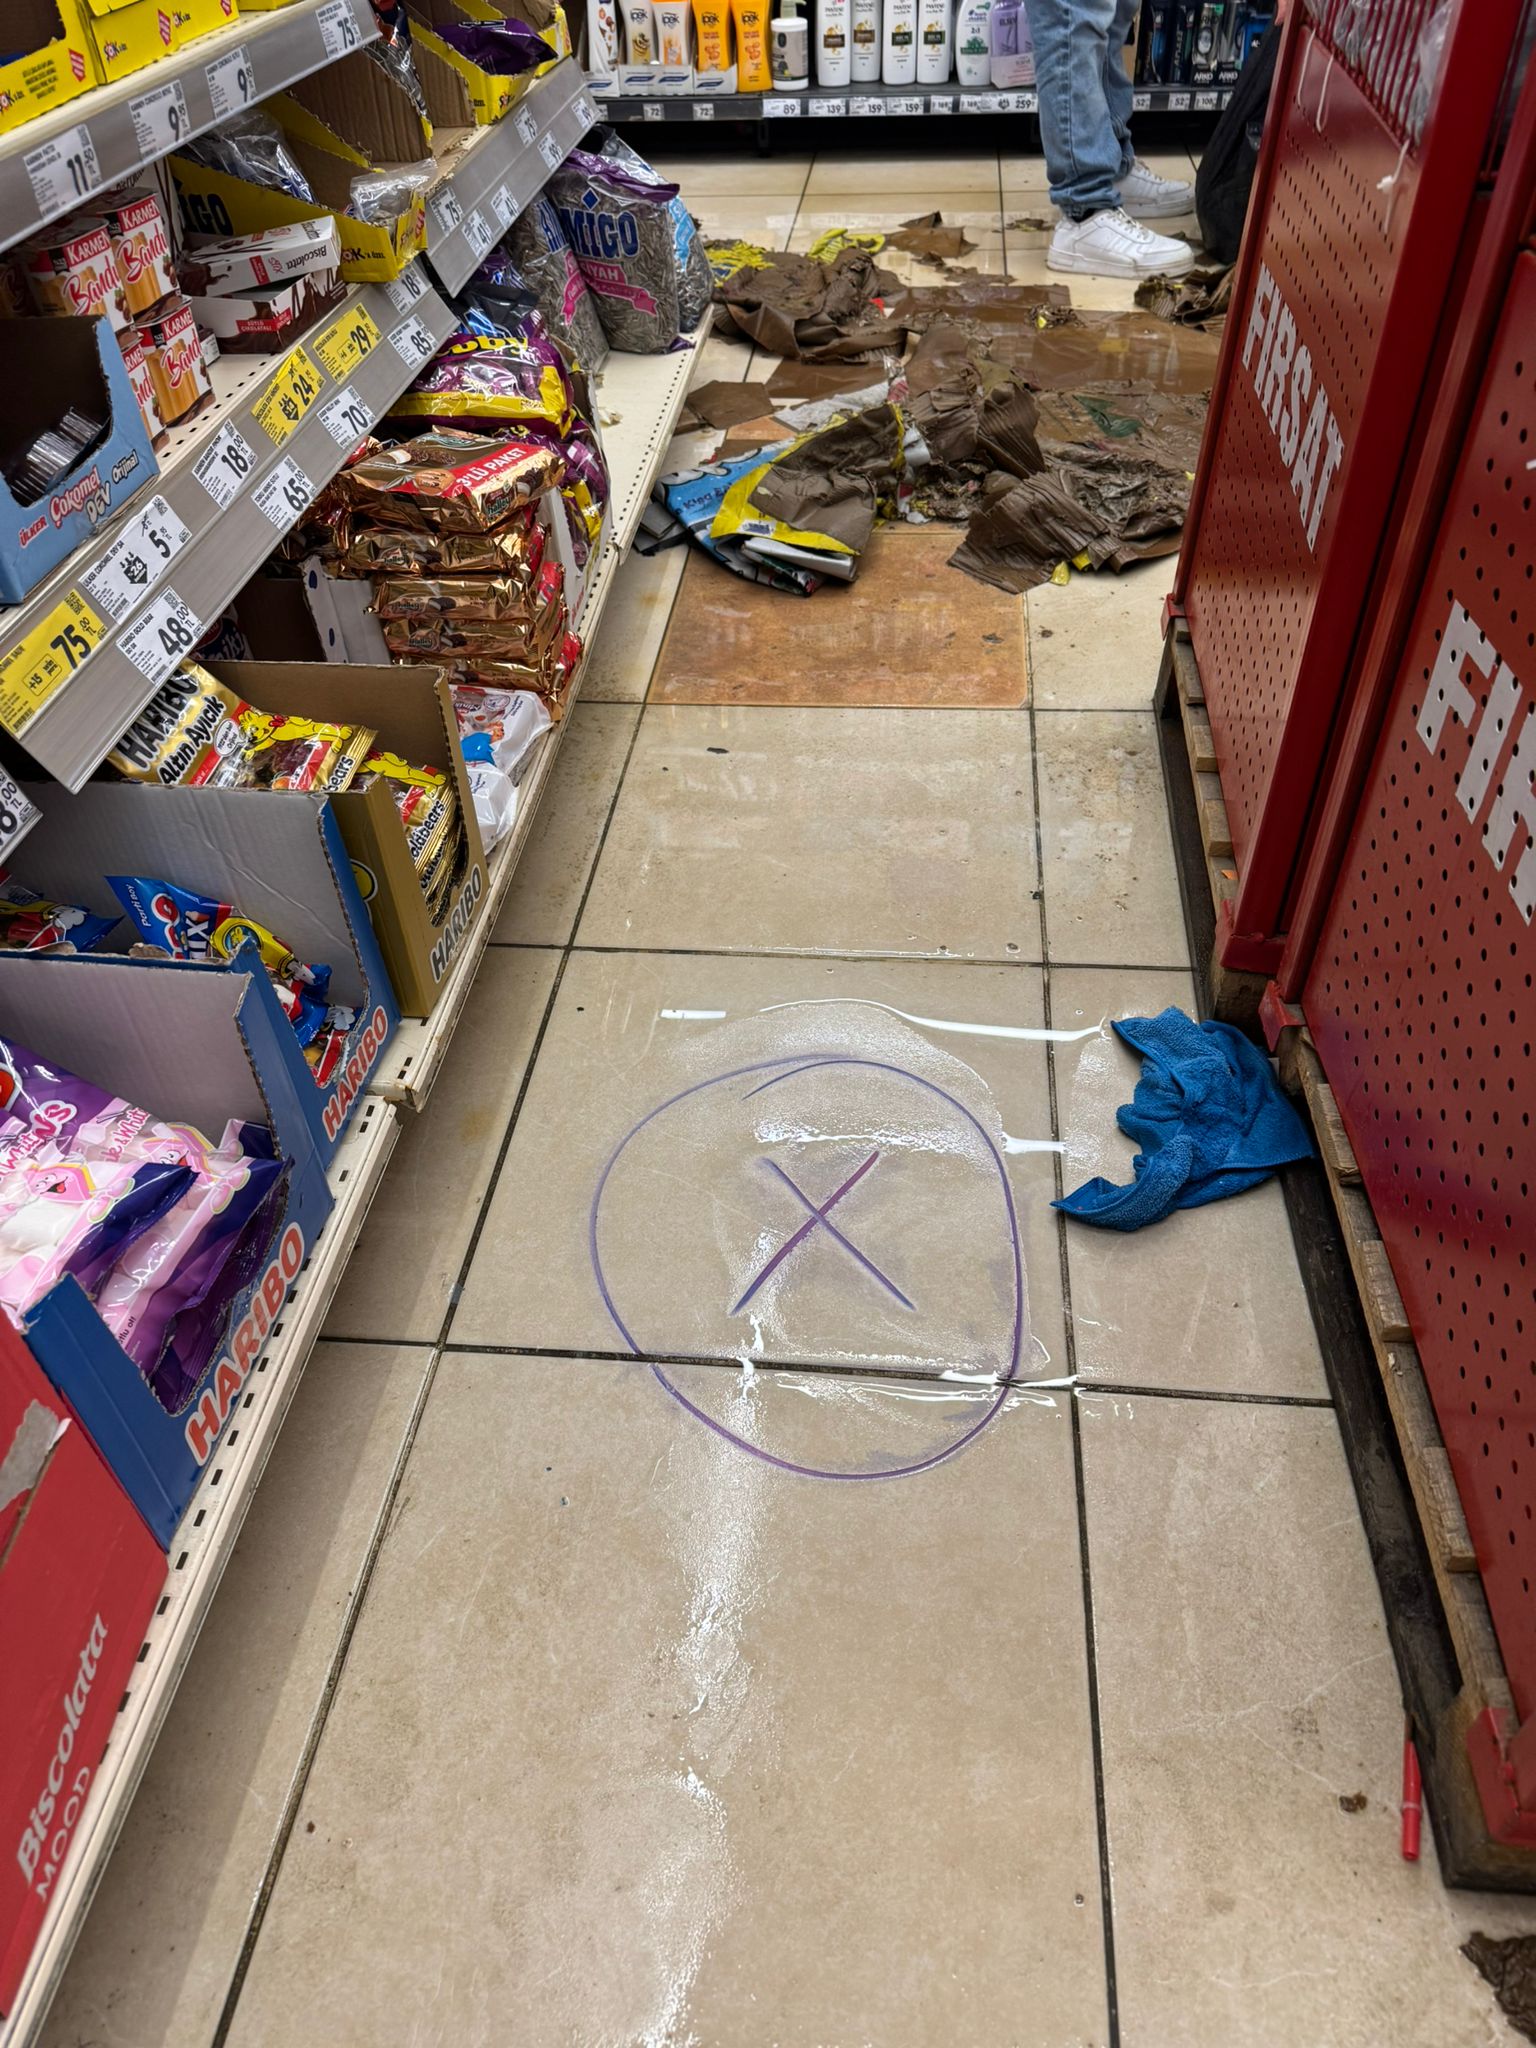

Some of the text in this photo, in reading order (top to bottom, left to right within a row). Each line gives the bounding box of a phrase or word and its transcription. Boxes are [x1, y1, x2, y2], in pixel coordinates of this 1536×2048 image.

[783, 104, 796, 115] 89
[350, 324, 372, 356] 29
[411, 331, 432, 356] 85
[293, 374, 315, 407] 24
[1242, 262, 1345, 554] FIRSAT
[341, 405, 369, 435] 70
[221, 444, 249, 480] 18
[456, 447, 527, 488] 3'LÜ PAKET
[19, 515, 48, 549] ÜLKER
[50, 465, 101, 530] Çokomel
[86, 480, 111, 525] DEV
[283, 478, 310, 512] 65
[149, 530, 171, 559] 5
[50, 623, 91, 671] 75
[157, 616, 194, 657] 48
[326, 754, 353, 792] bears
[410, 800, 446, 858] oldbears
[430, 863, 483, 983] HARIBO
[322, 1005, 389, 1142] HARIBO
[186, 1222, 304, 1465] HARIBO
[17, 1612, 108, 1885] Biscolata
[36, 1765, 90, 1902] MOOD
